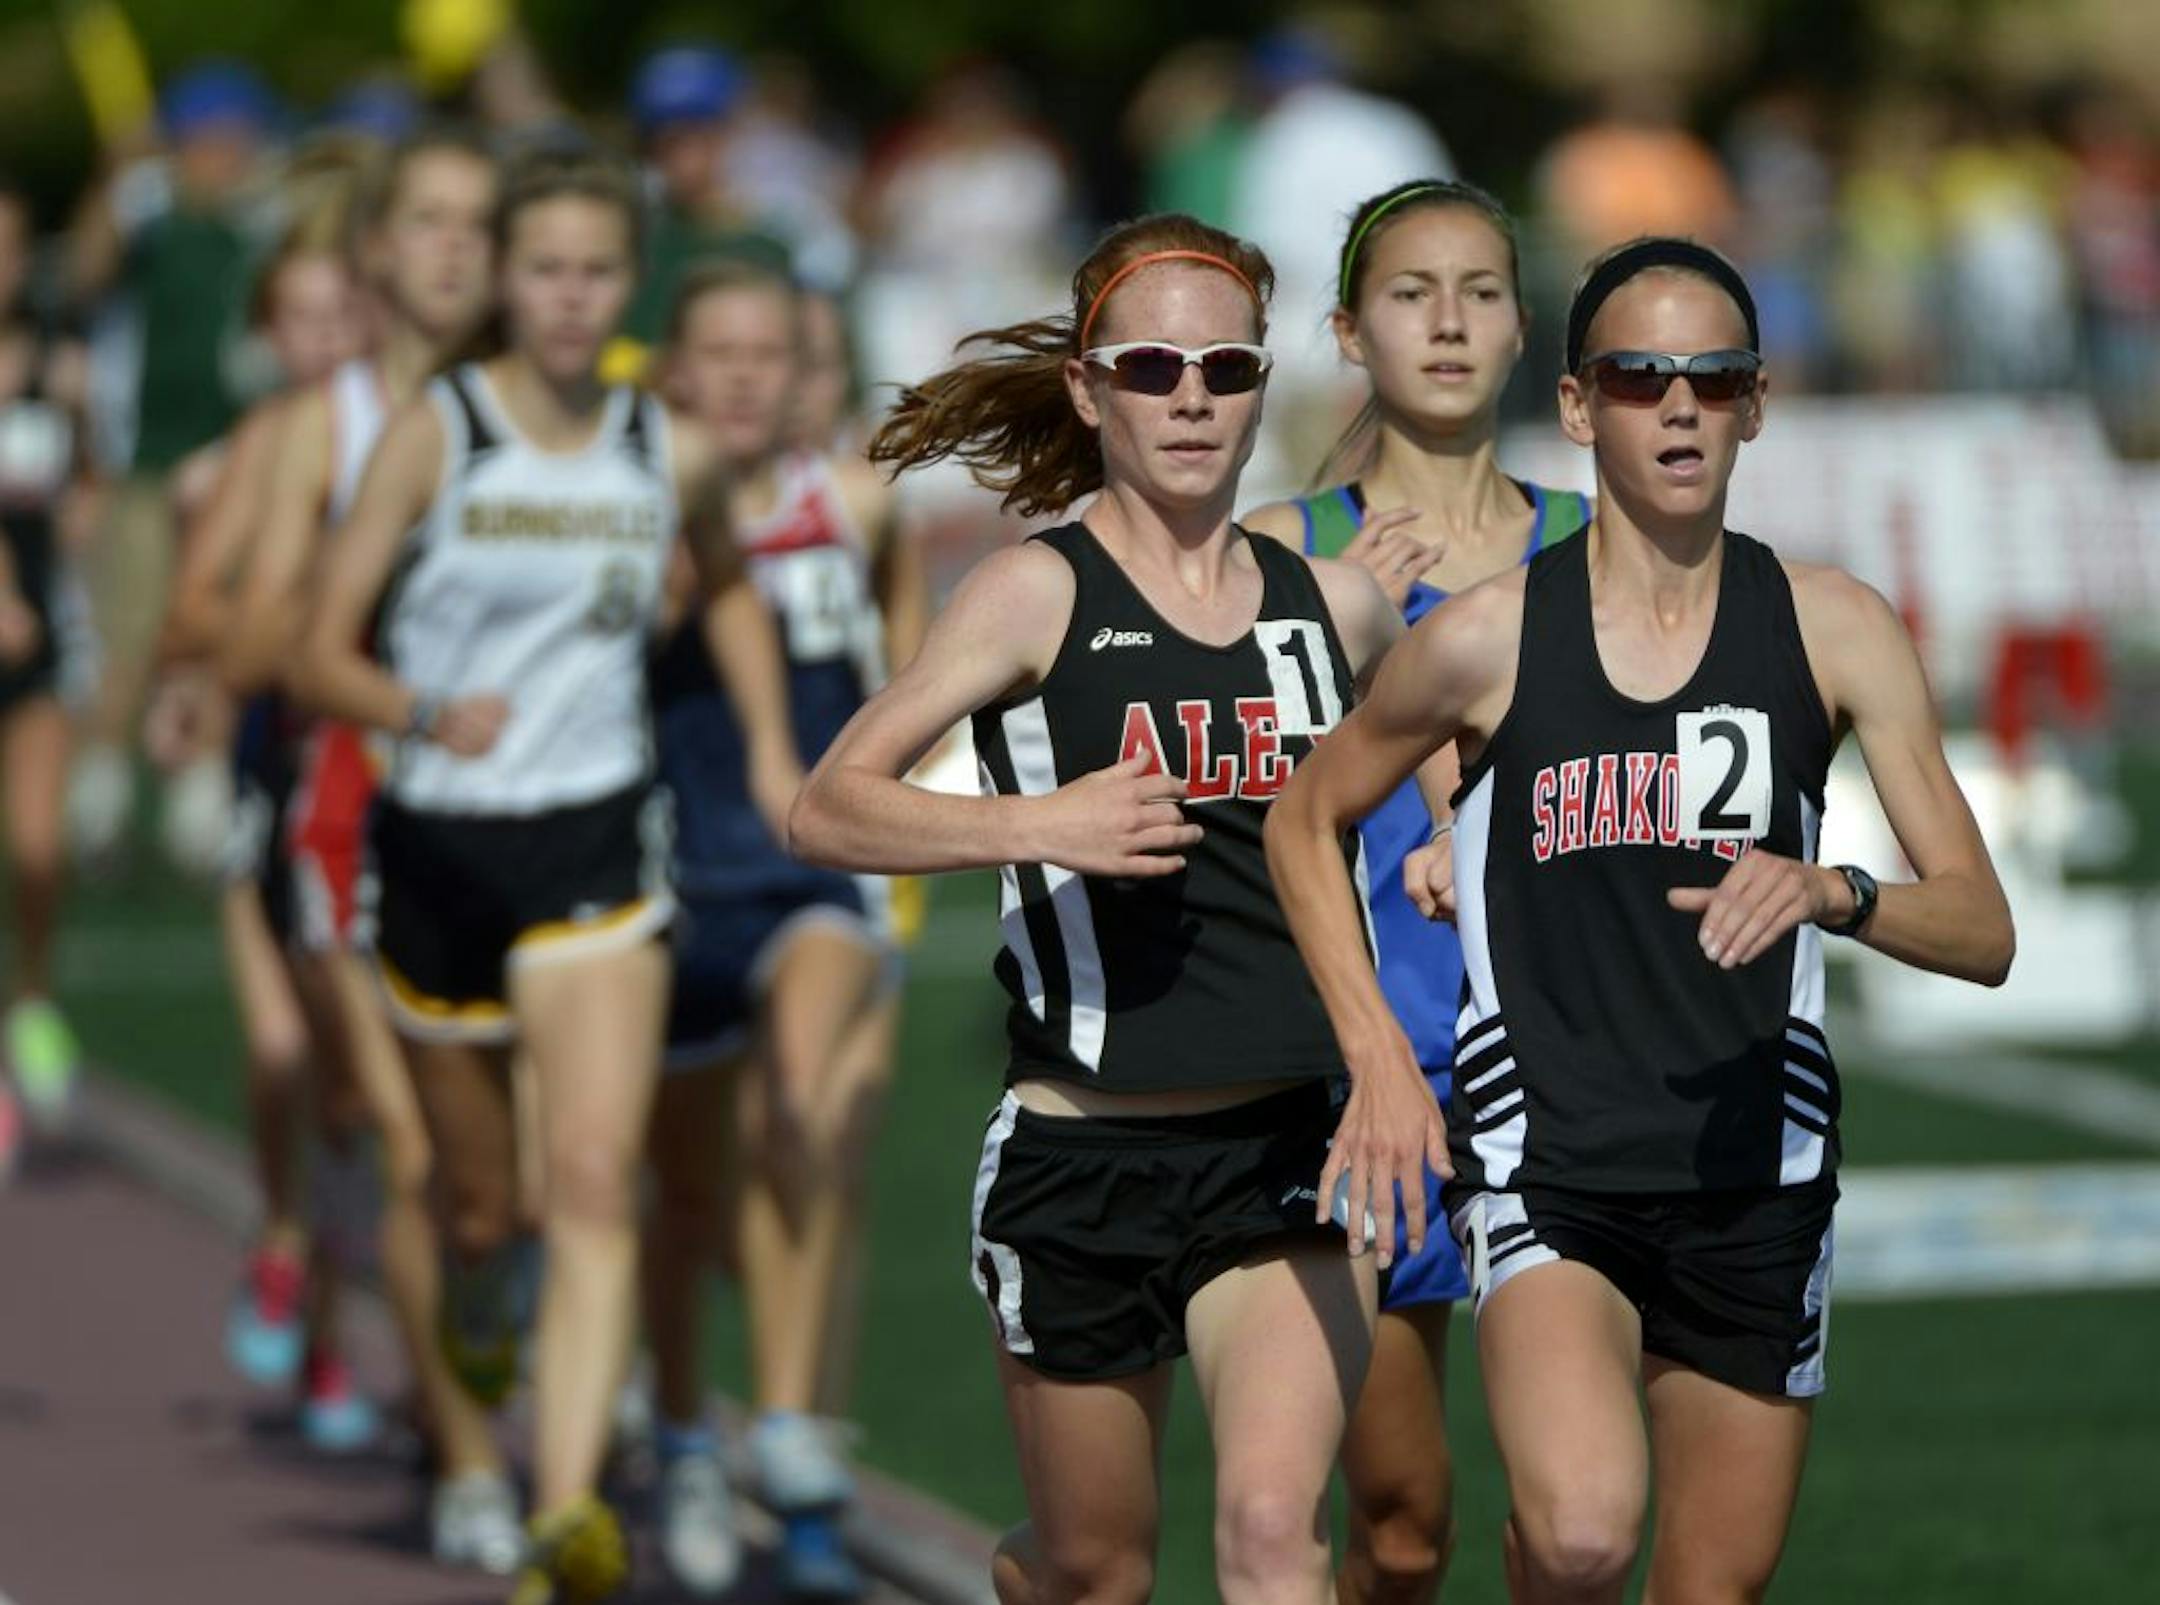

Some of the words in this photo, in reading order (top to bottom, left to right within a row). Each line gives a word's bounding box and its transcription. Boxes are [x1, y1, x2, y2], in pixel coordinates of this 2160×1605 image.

[1112, 630, 1154, 647] asics
[1276, 628, 1326, 726] 1
[1117, 697, 1330, 805] ALE
[1699, 719, 1751, 830] 2
[1533, 752, 1753, 863] SHAKO
